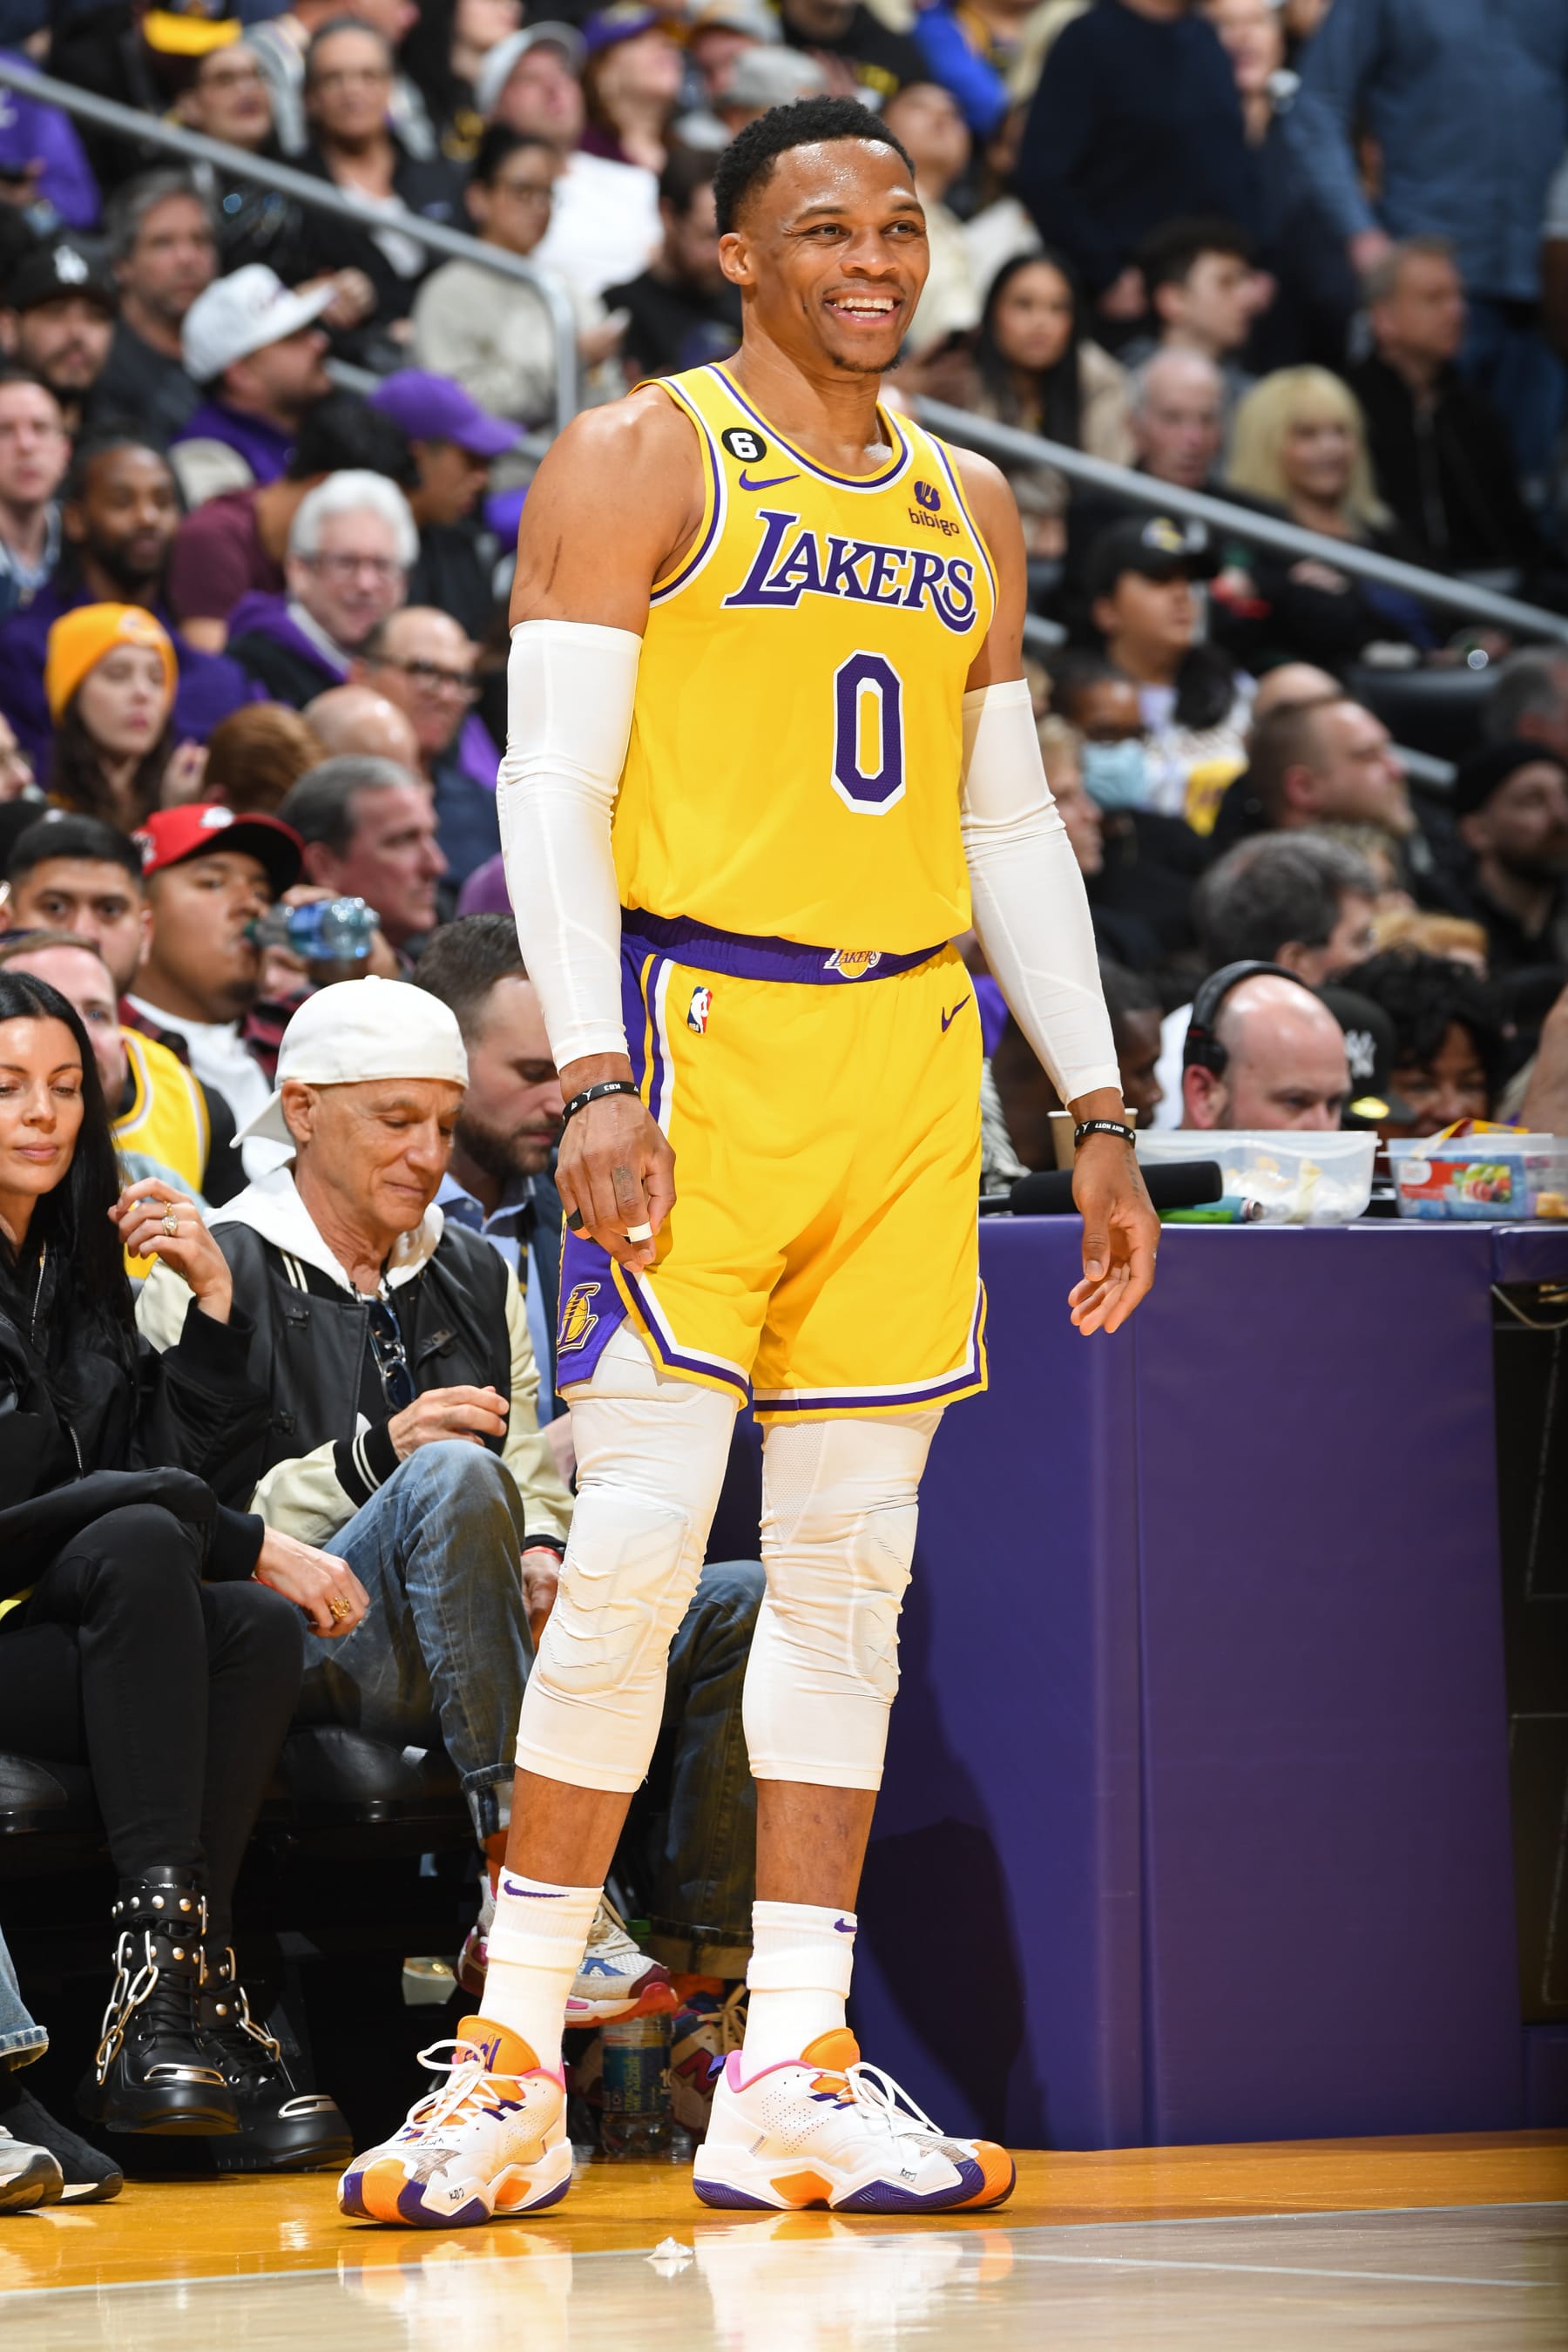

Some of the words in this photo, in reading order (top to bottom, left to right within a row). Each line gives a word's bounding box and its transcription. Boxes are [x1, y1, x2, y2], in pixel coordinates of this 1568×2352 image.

[731, 432, 759, 458] 6
[908, 508, 960, 537] bibigo
[720, 508, 979, 636] LAKERS
[830, 649, 906, 816] 0
[823, 949, 882, 968] LAKERS
